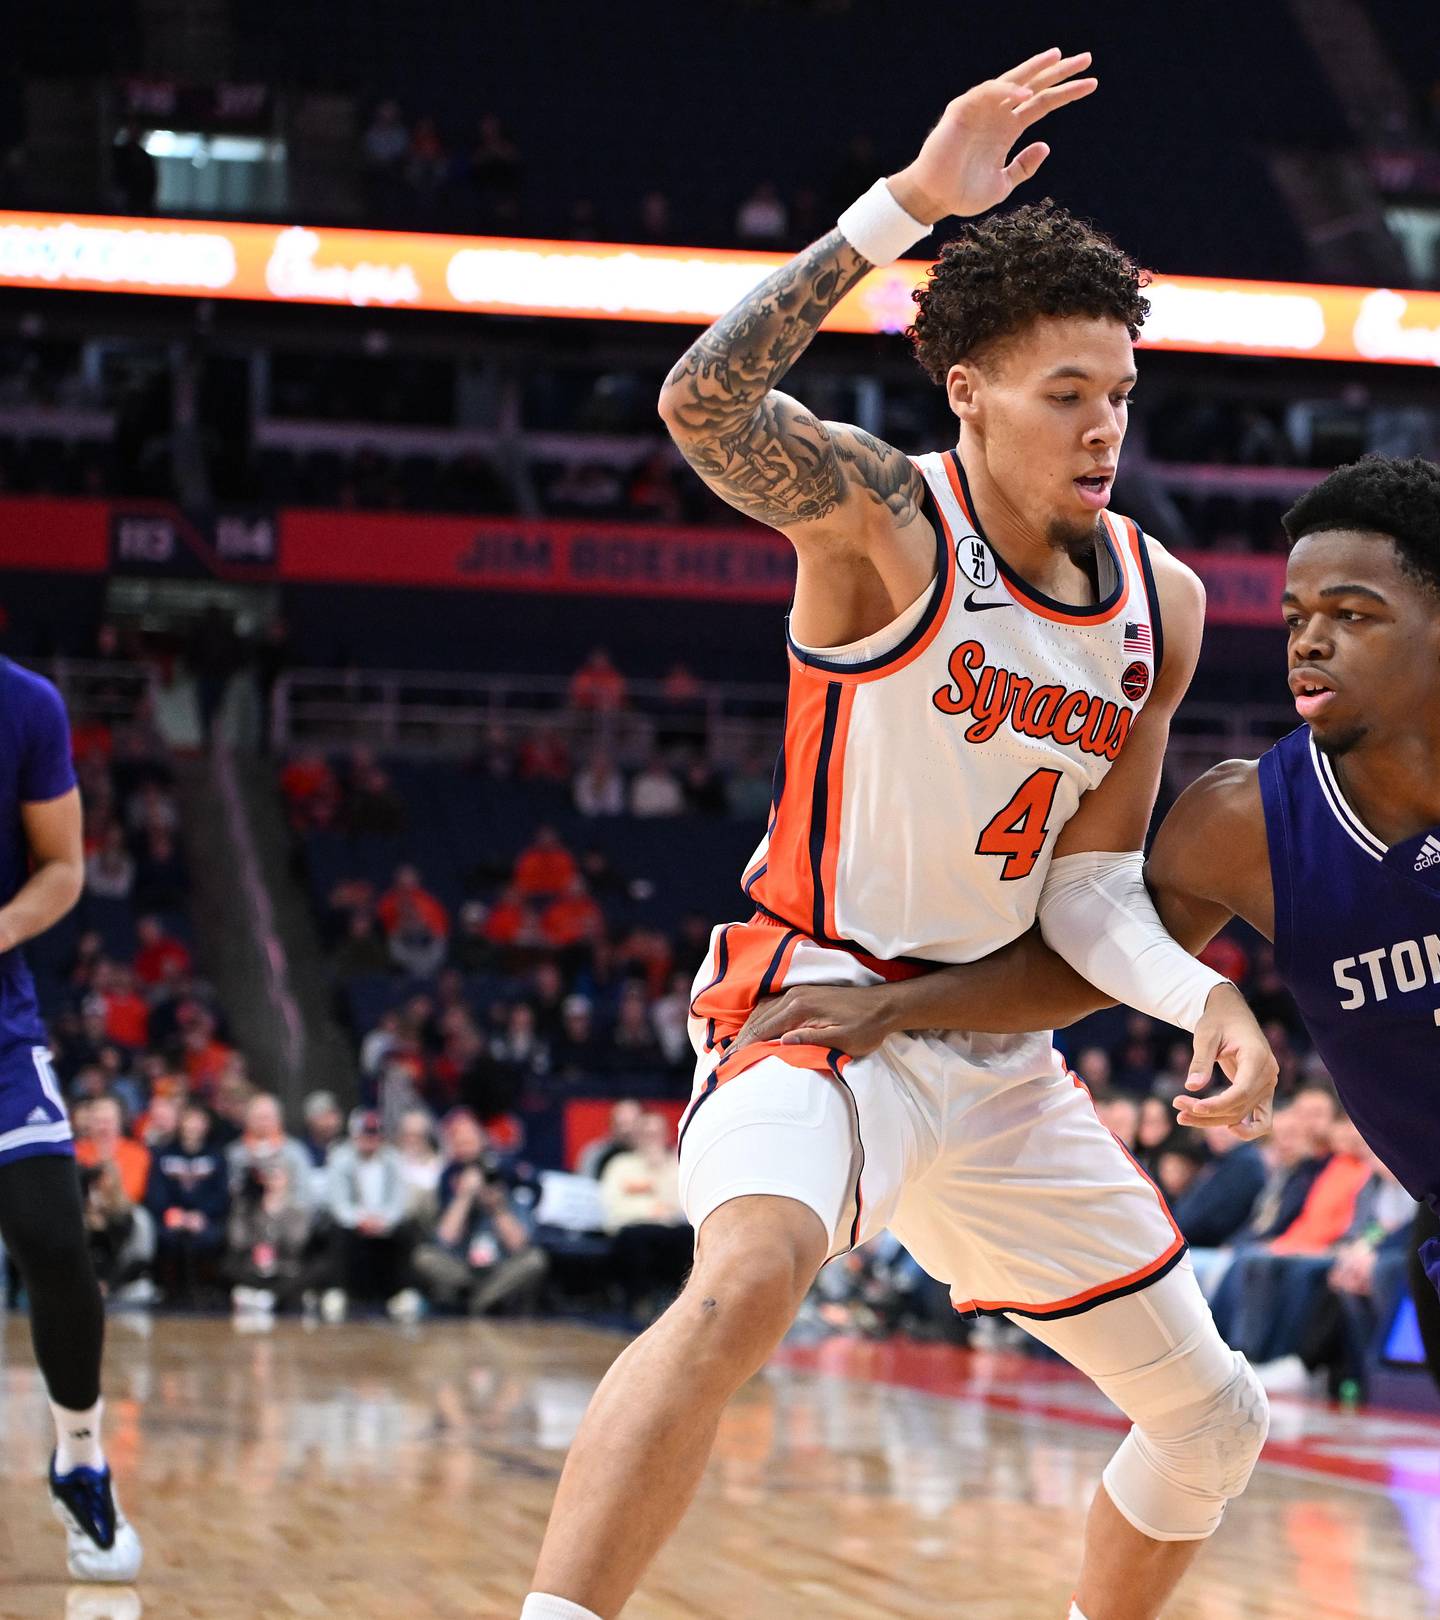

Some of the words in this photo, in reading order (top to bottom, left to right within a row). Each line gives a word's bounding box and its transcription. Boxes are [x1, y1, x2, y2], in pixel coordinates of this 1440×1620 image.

[456, 531, 552, 577] JIM
[569, 536, 797, 589] BOEHEIM
[973, 557, 985, 582] 21
[932, 640, 1134, 762] Syracus
[974, 766, 1064, 881] 4
